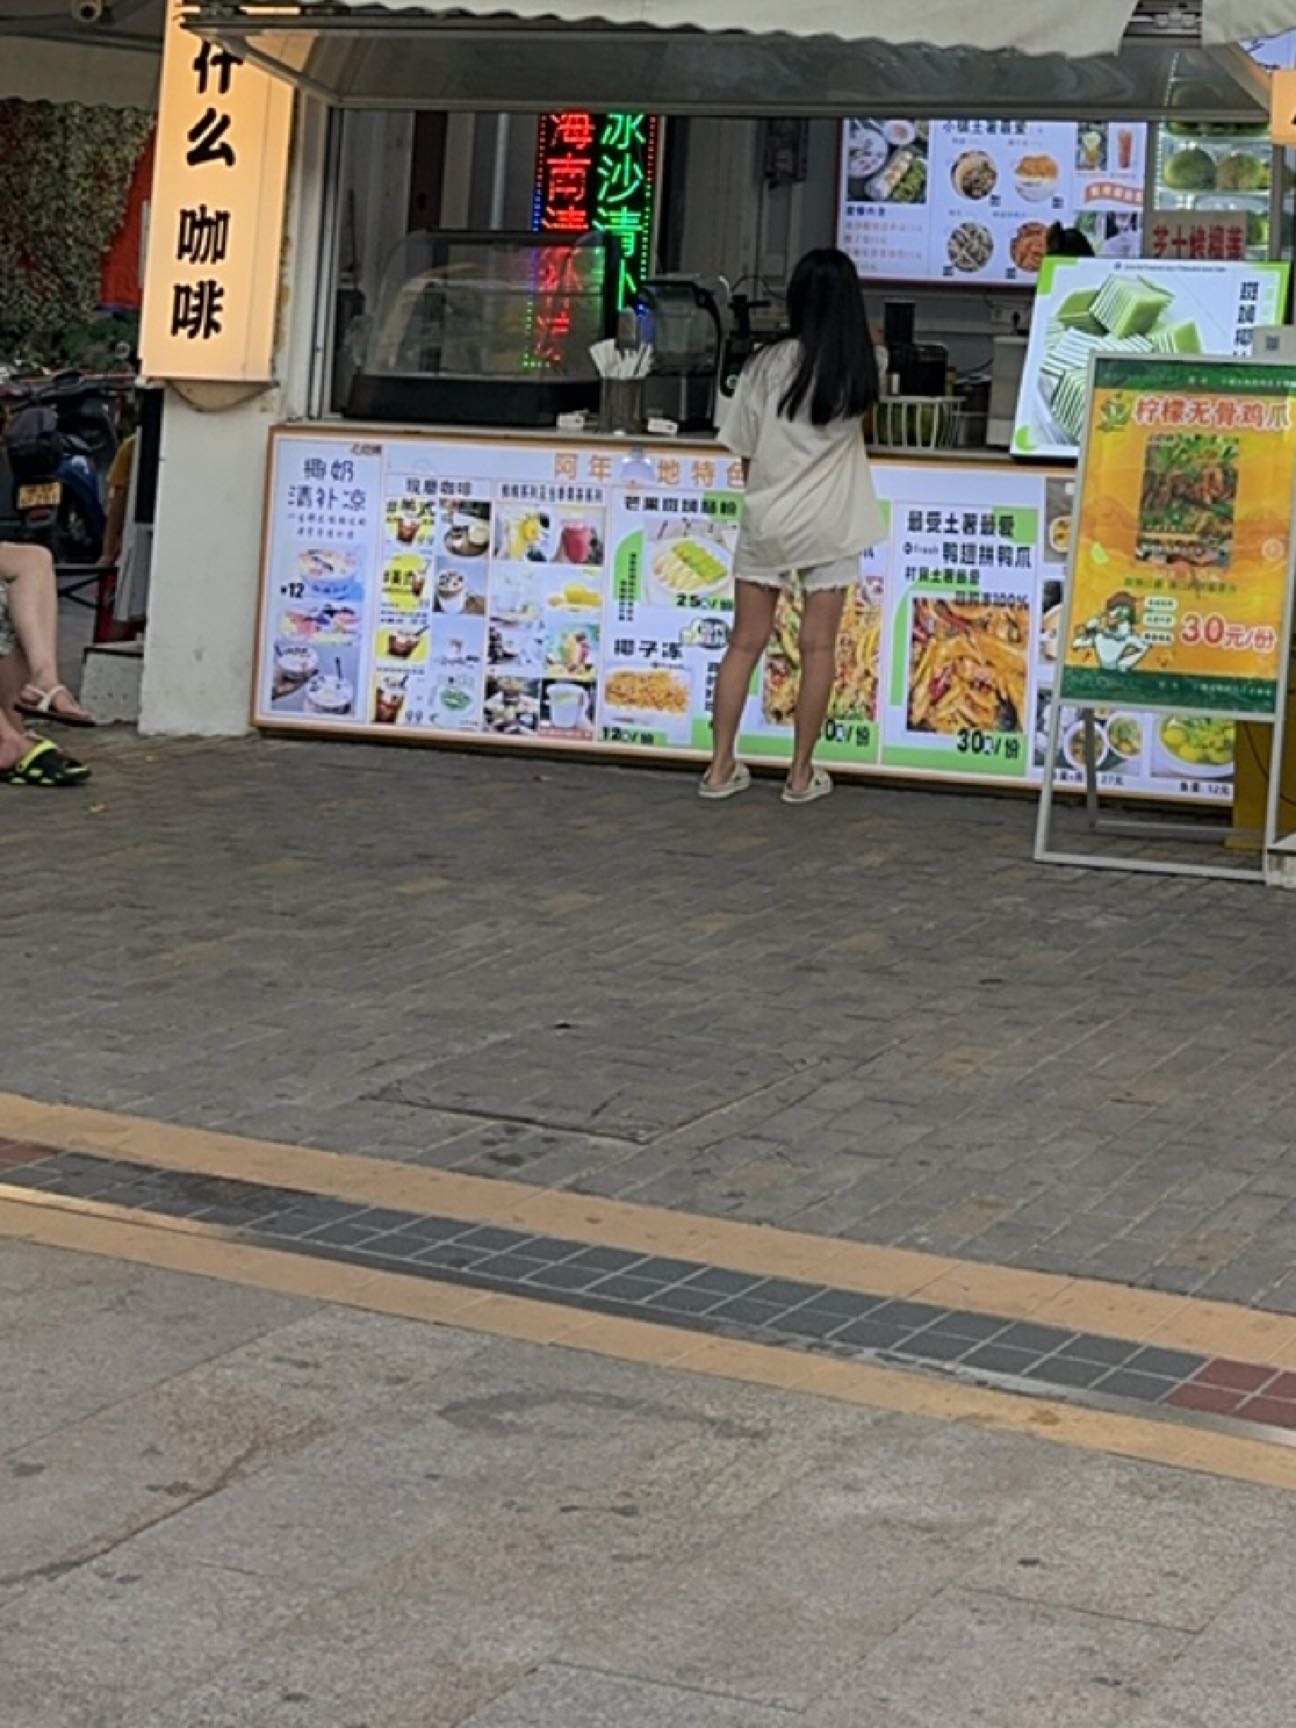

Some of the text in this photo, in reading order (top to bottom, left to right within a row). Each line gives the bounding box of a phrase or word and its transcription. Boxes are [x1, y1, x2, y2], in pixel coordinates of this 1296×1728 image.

[171, 42, 242, 339] 什么咖啡
[1136, 396, 1289, 429] 柠檬无骨鸡爪
[554, 452, 745, 489] 阿年地特色
[288, 485, 366, 511] 清补凉
[614, 639, 683, 660] 椰子冻
[1181, 613, 1276, 652] 30元/份
